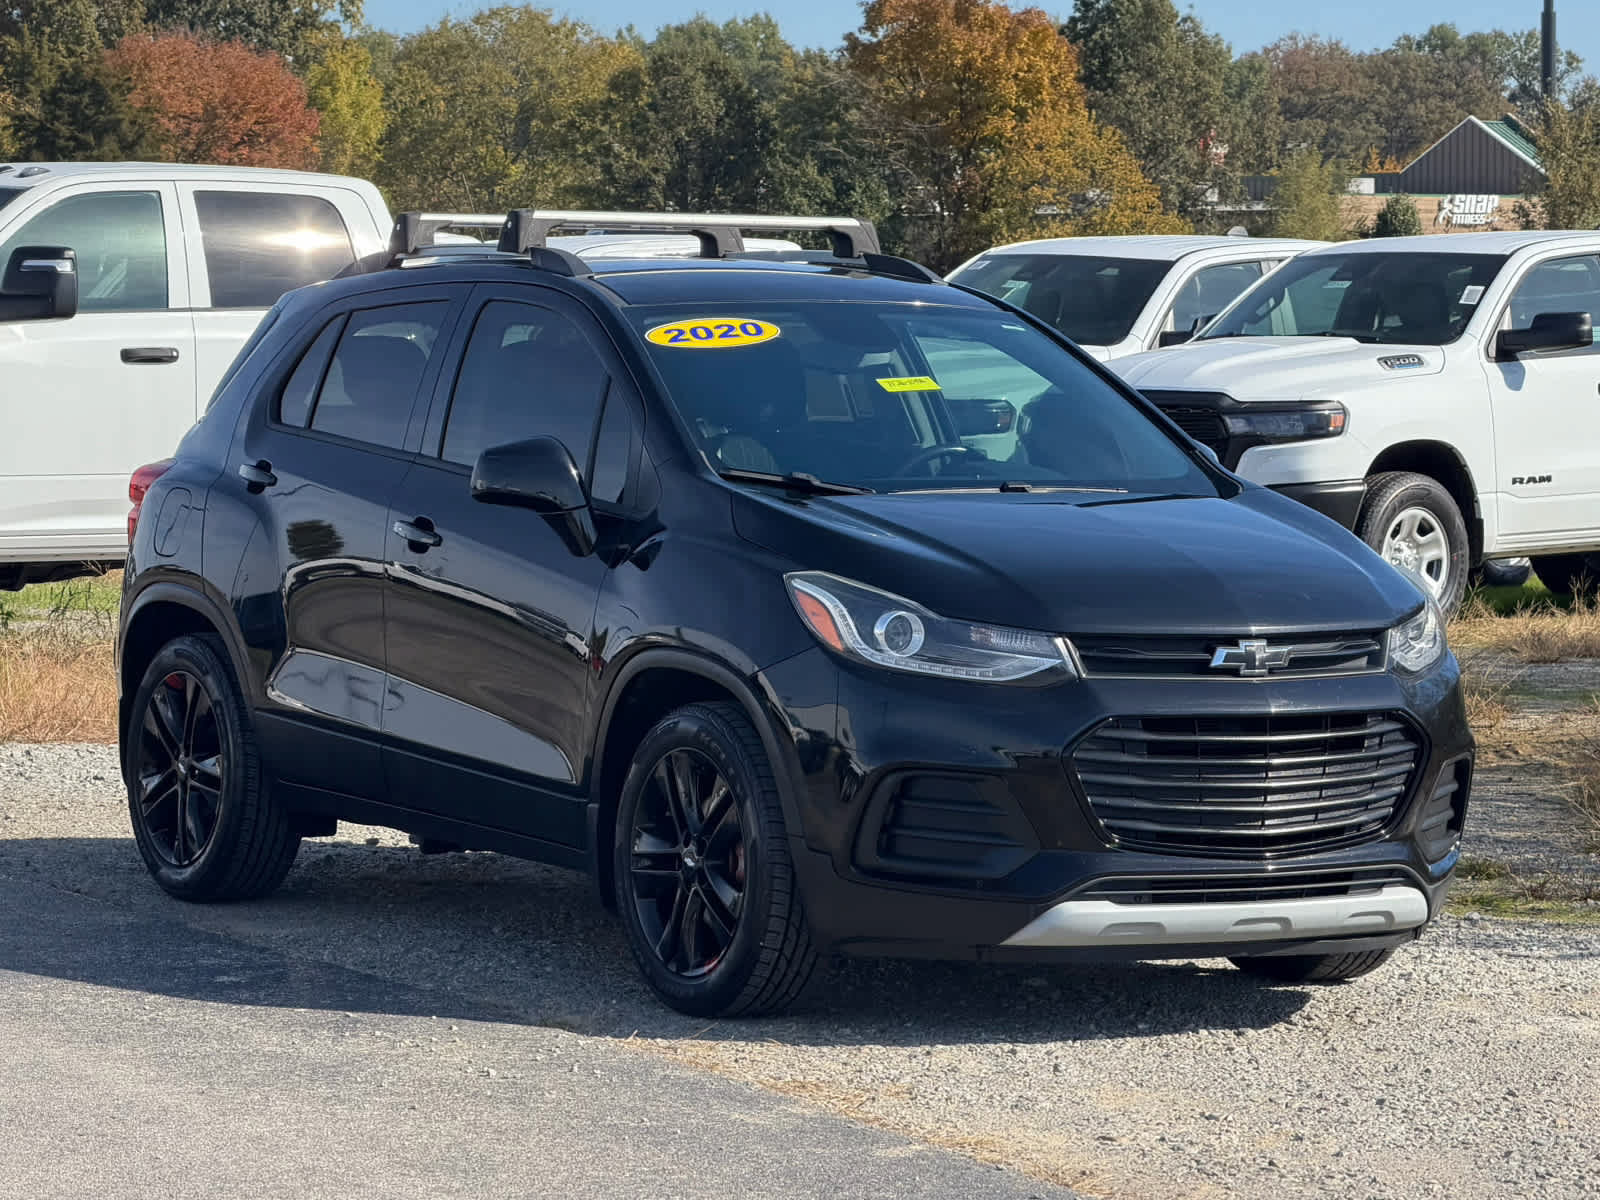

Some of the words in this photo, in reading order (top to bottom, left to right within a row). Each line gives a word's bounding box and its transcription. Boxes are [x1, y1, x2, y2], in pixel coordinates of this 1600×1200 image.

[663, 322, 764, 343] 2020
[1386, 356, 1419, 367] 1500
[1511, 475, 1553, 486] RAM
